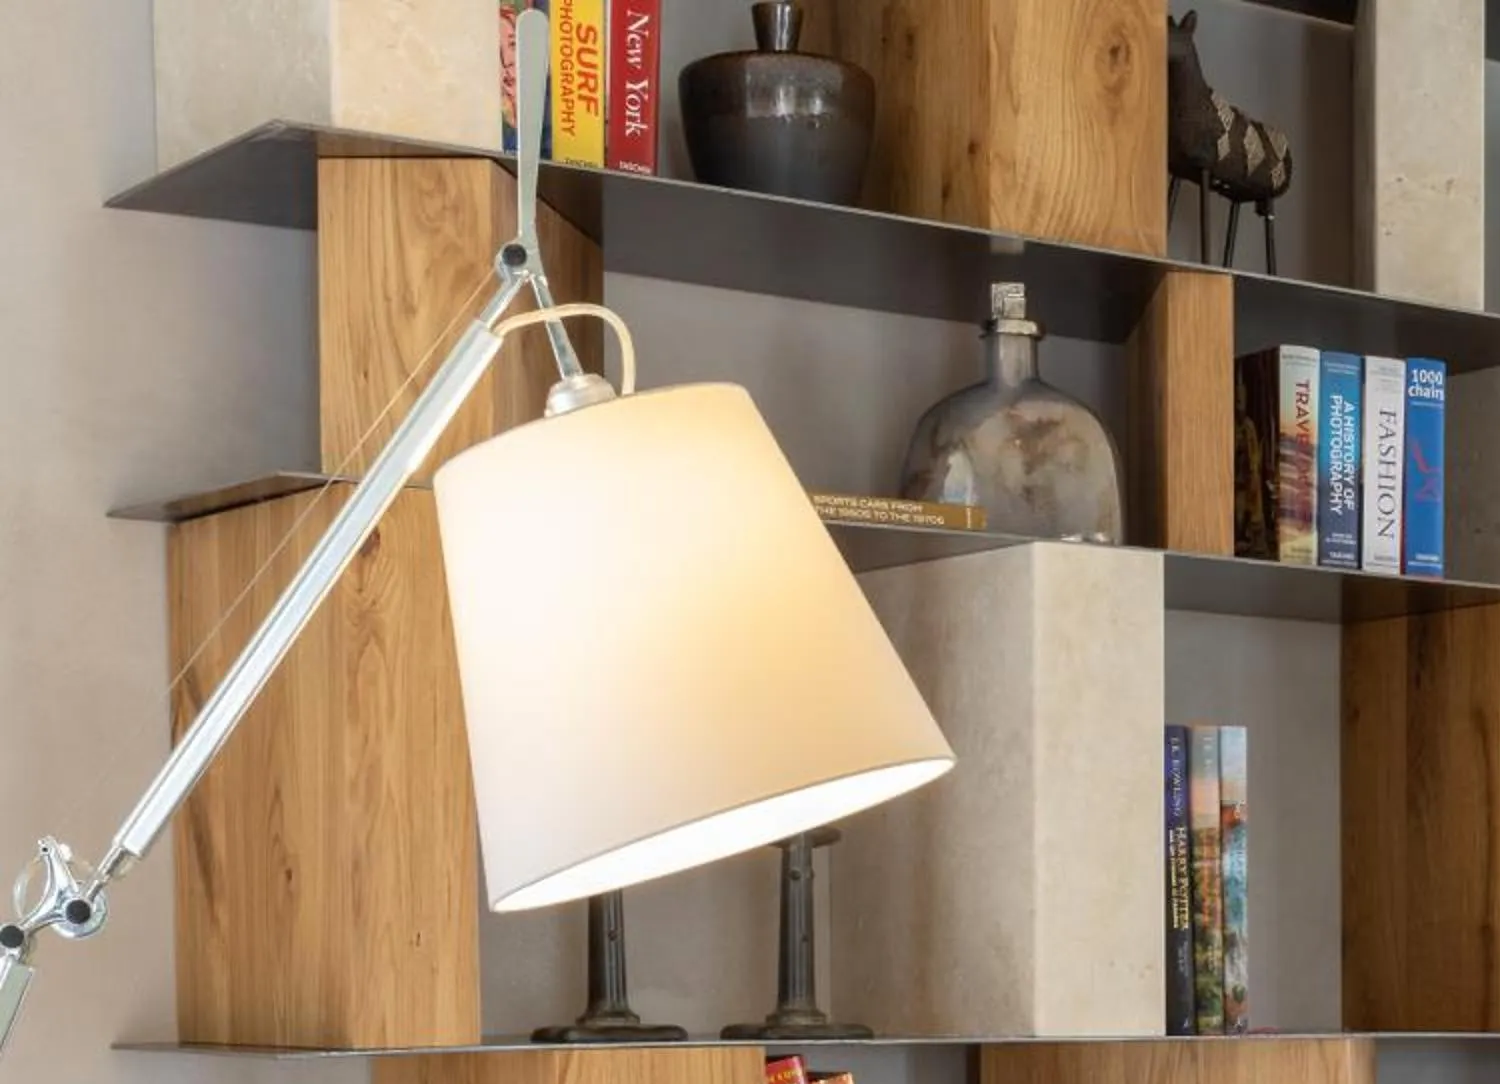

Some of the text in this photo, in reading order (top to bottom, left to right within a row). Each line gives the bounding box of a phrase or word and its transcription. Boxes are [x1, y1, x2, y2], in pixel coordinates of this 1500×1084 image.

[575, 21, 599, 117] SURF
[624, 9, 650, 137] New York
[1329, 394, 1343, 516] PHOTOGRAPHY
[1343, 400, 1355, 511] A HISTORY OF
[1376, 408, 1397, 540] FASHION
